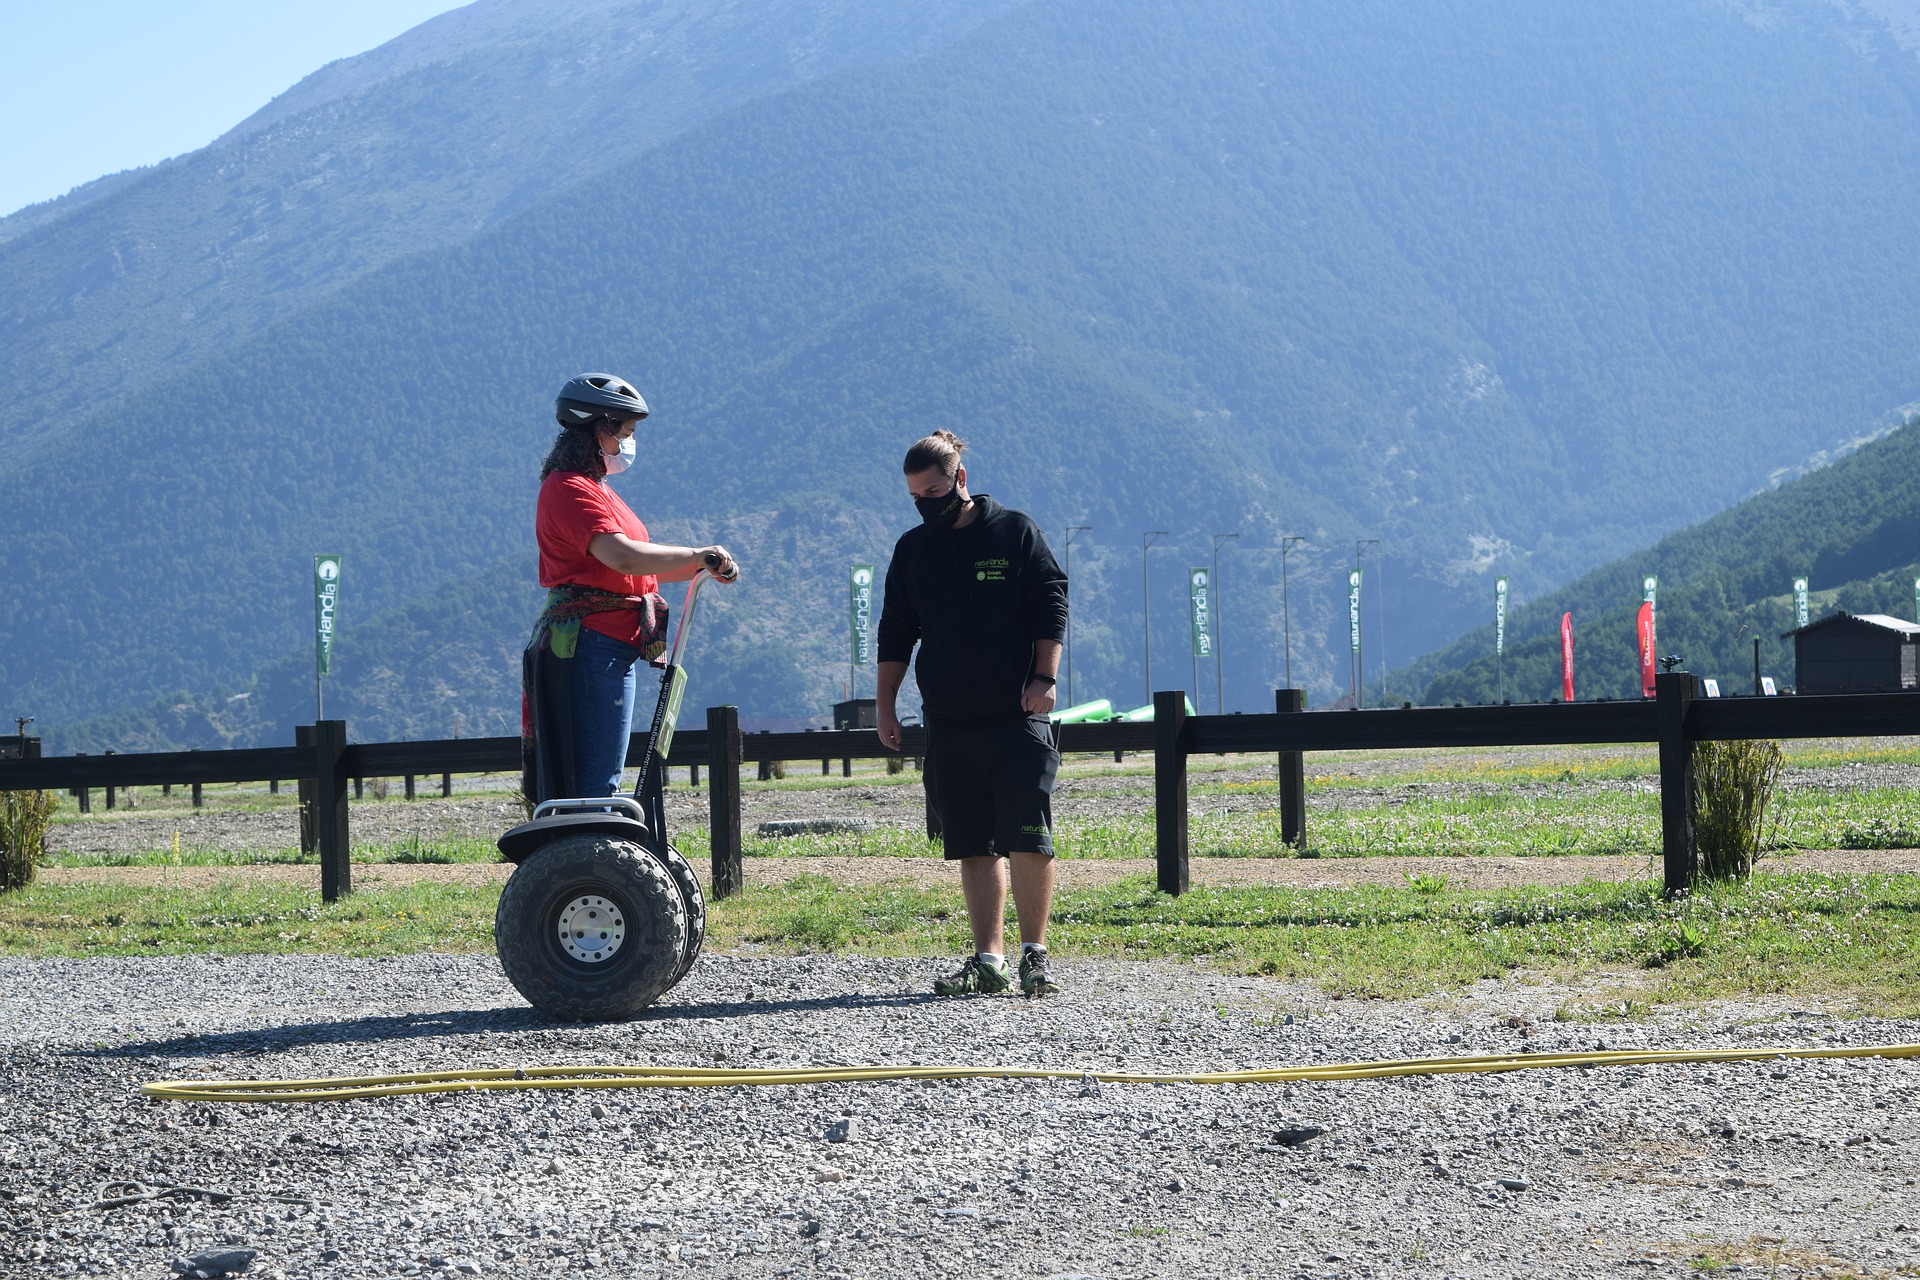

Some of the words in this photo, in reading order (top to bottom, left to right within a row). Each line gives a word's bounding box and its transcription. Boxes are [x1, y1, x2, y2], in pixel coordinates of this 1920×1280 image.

[975, 557, 1009, 567] naturlandia
[853, 588, 869, 664] naturlandia
[1192, 588, 1209, 654] naturlandia
[636, 682, 670, 797] www.andorrasegwaytour.com
